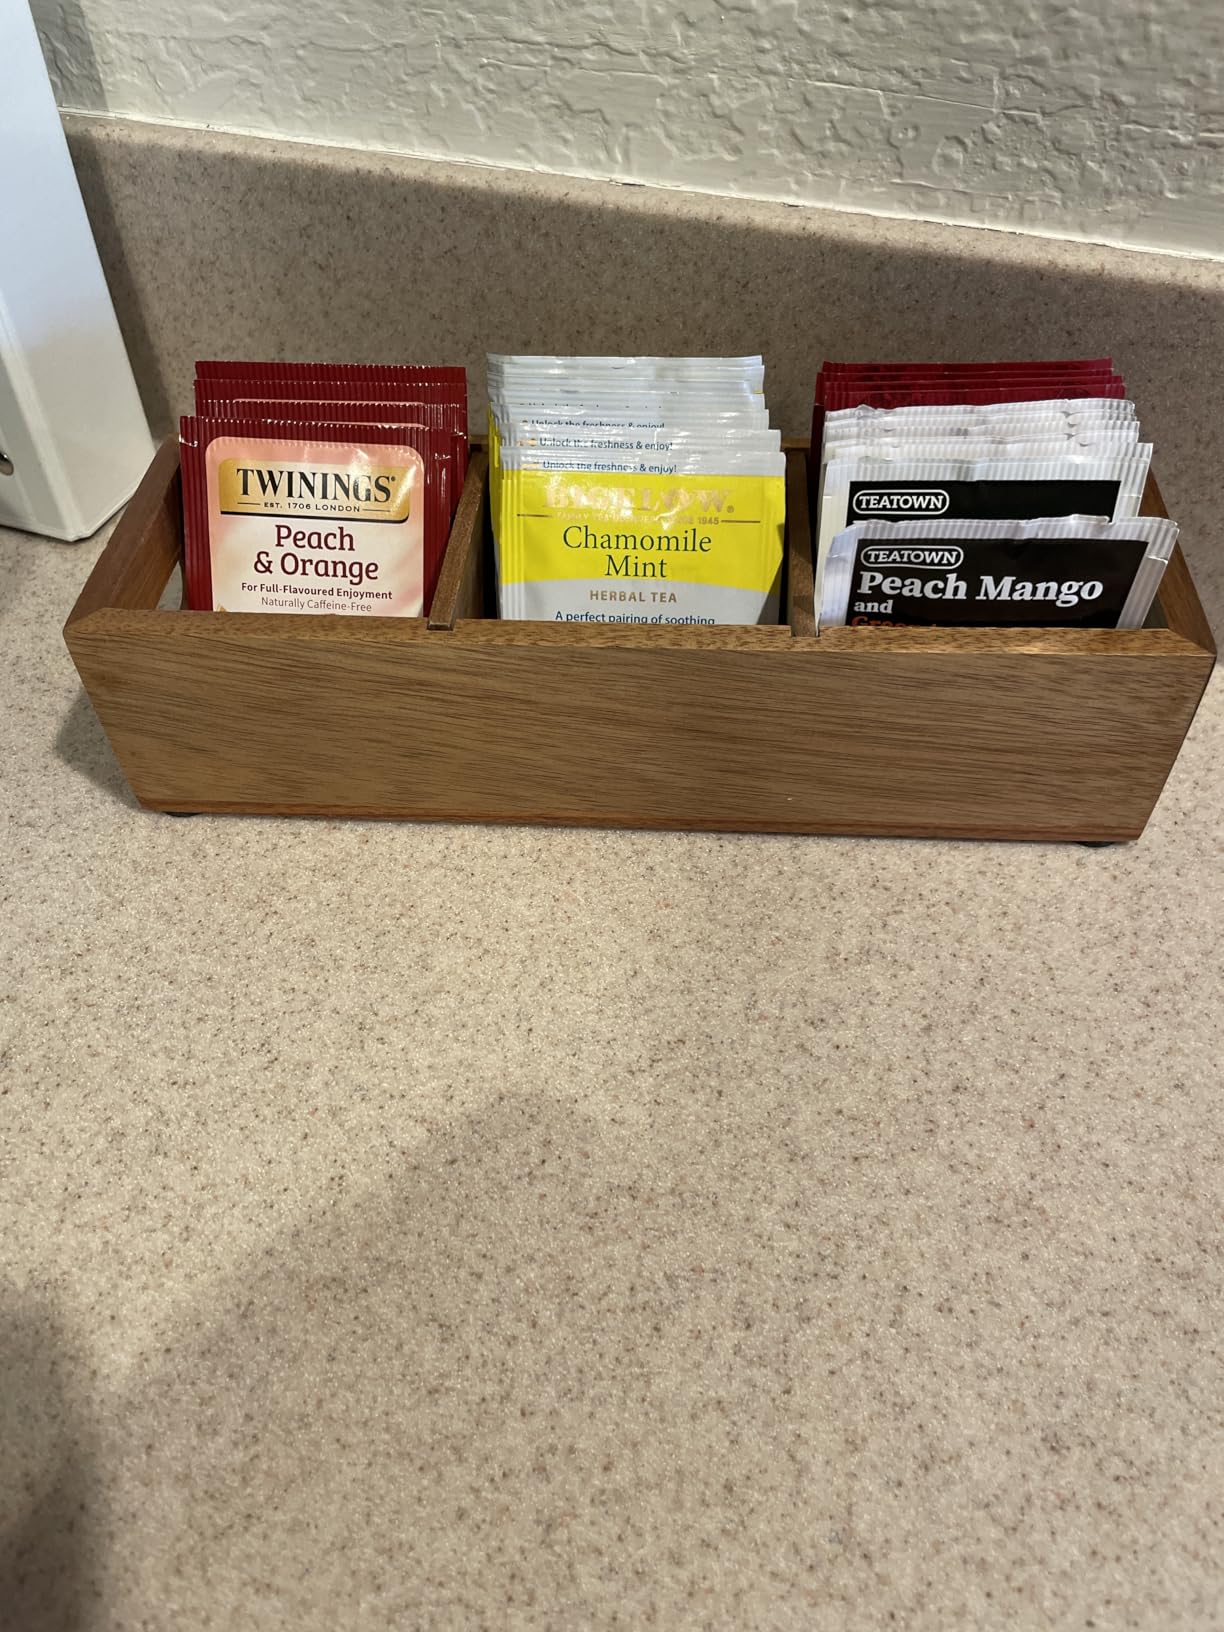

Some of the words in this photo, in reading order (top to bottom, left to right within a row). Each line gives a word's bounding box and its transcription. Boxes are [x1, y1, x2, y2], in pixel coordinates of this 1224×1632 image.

[591, 439, 634, 449] freshness
[635, 441, 643, 450] &
[645, 441, 673, 452] enjoy!
[640, 464, 647, 472] &
[648, 464, 677, 475] enjoy!
[236, 468, 391, 503] TWININGS
[315, 504, 360, 512] LONDON
[859, 495, 944, 509] TEATOWN
[275, 524, 355, 551] Peach
[563, 525, 712, 552] Chamomile
[867, 550, 958, 565] TEATOWN
[254, 550, 273, 574] &
[280, 552, 379, 586] Orange
[604, 554, 668, 578] Mint
[241, 582, 257, 592] For
[260, 583, 334, 597] Full-Flavoured
[336, 588, 393, 600] Enjoyment
[589, 589, 646, 602] HERBAL
[650, 591, 678, 603] TEA
[857, 570, 967, 600] Peach
[975, 575, 1104, 608] Mango
[261, 596, 305, 610] Naturally
[307, 599, 372, 612] Caffeine-Free
[853, 599, 894, 614] and
[555, 610, 563, 621] A
[566, 611, 605, 622] perfect
[608, 613, 648, 624] pairing
[650, 613, 663, 624] of
[665, 614, 715, 625] soothing
